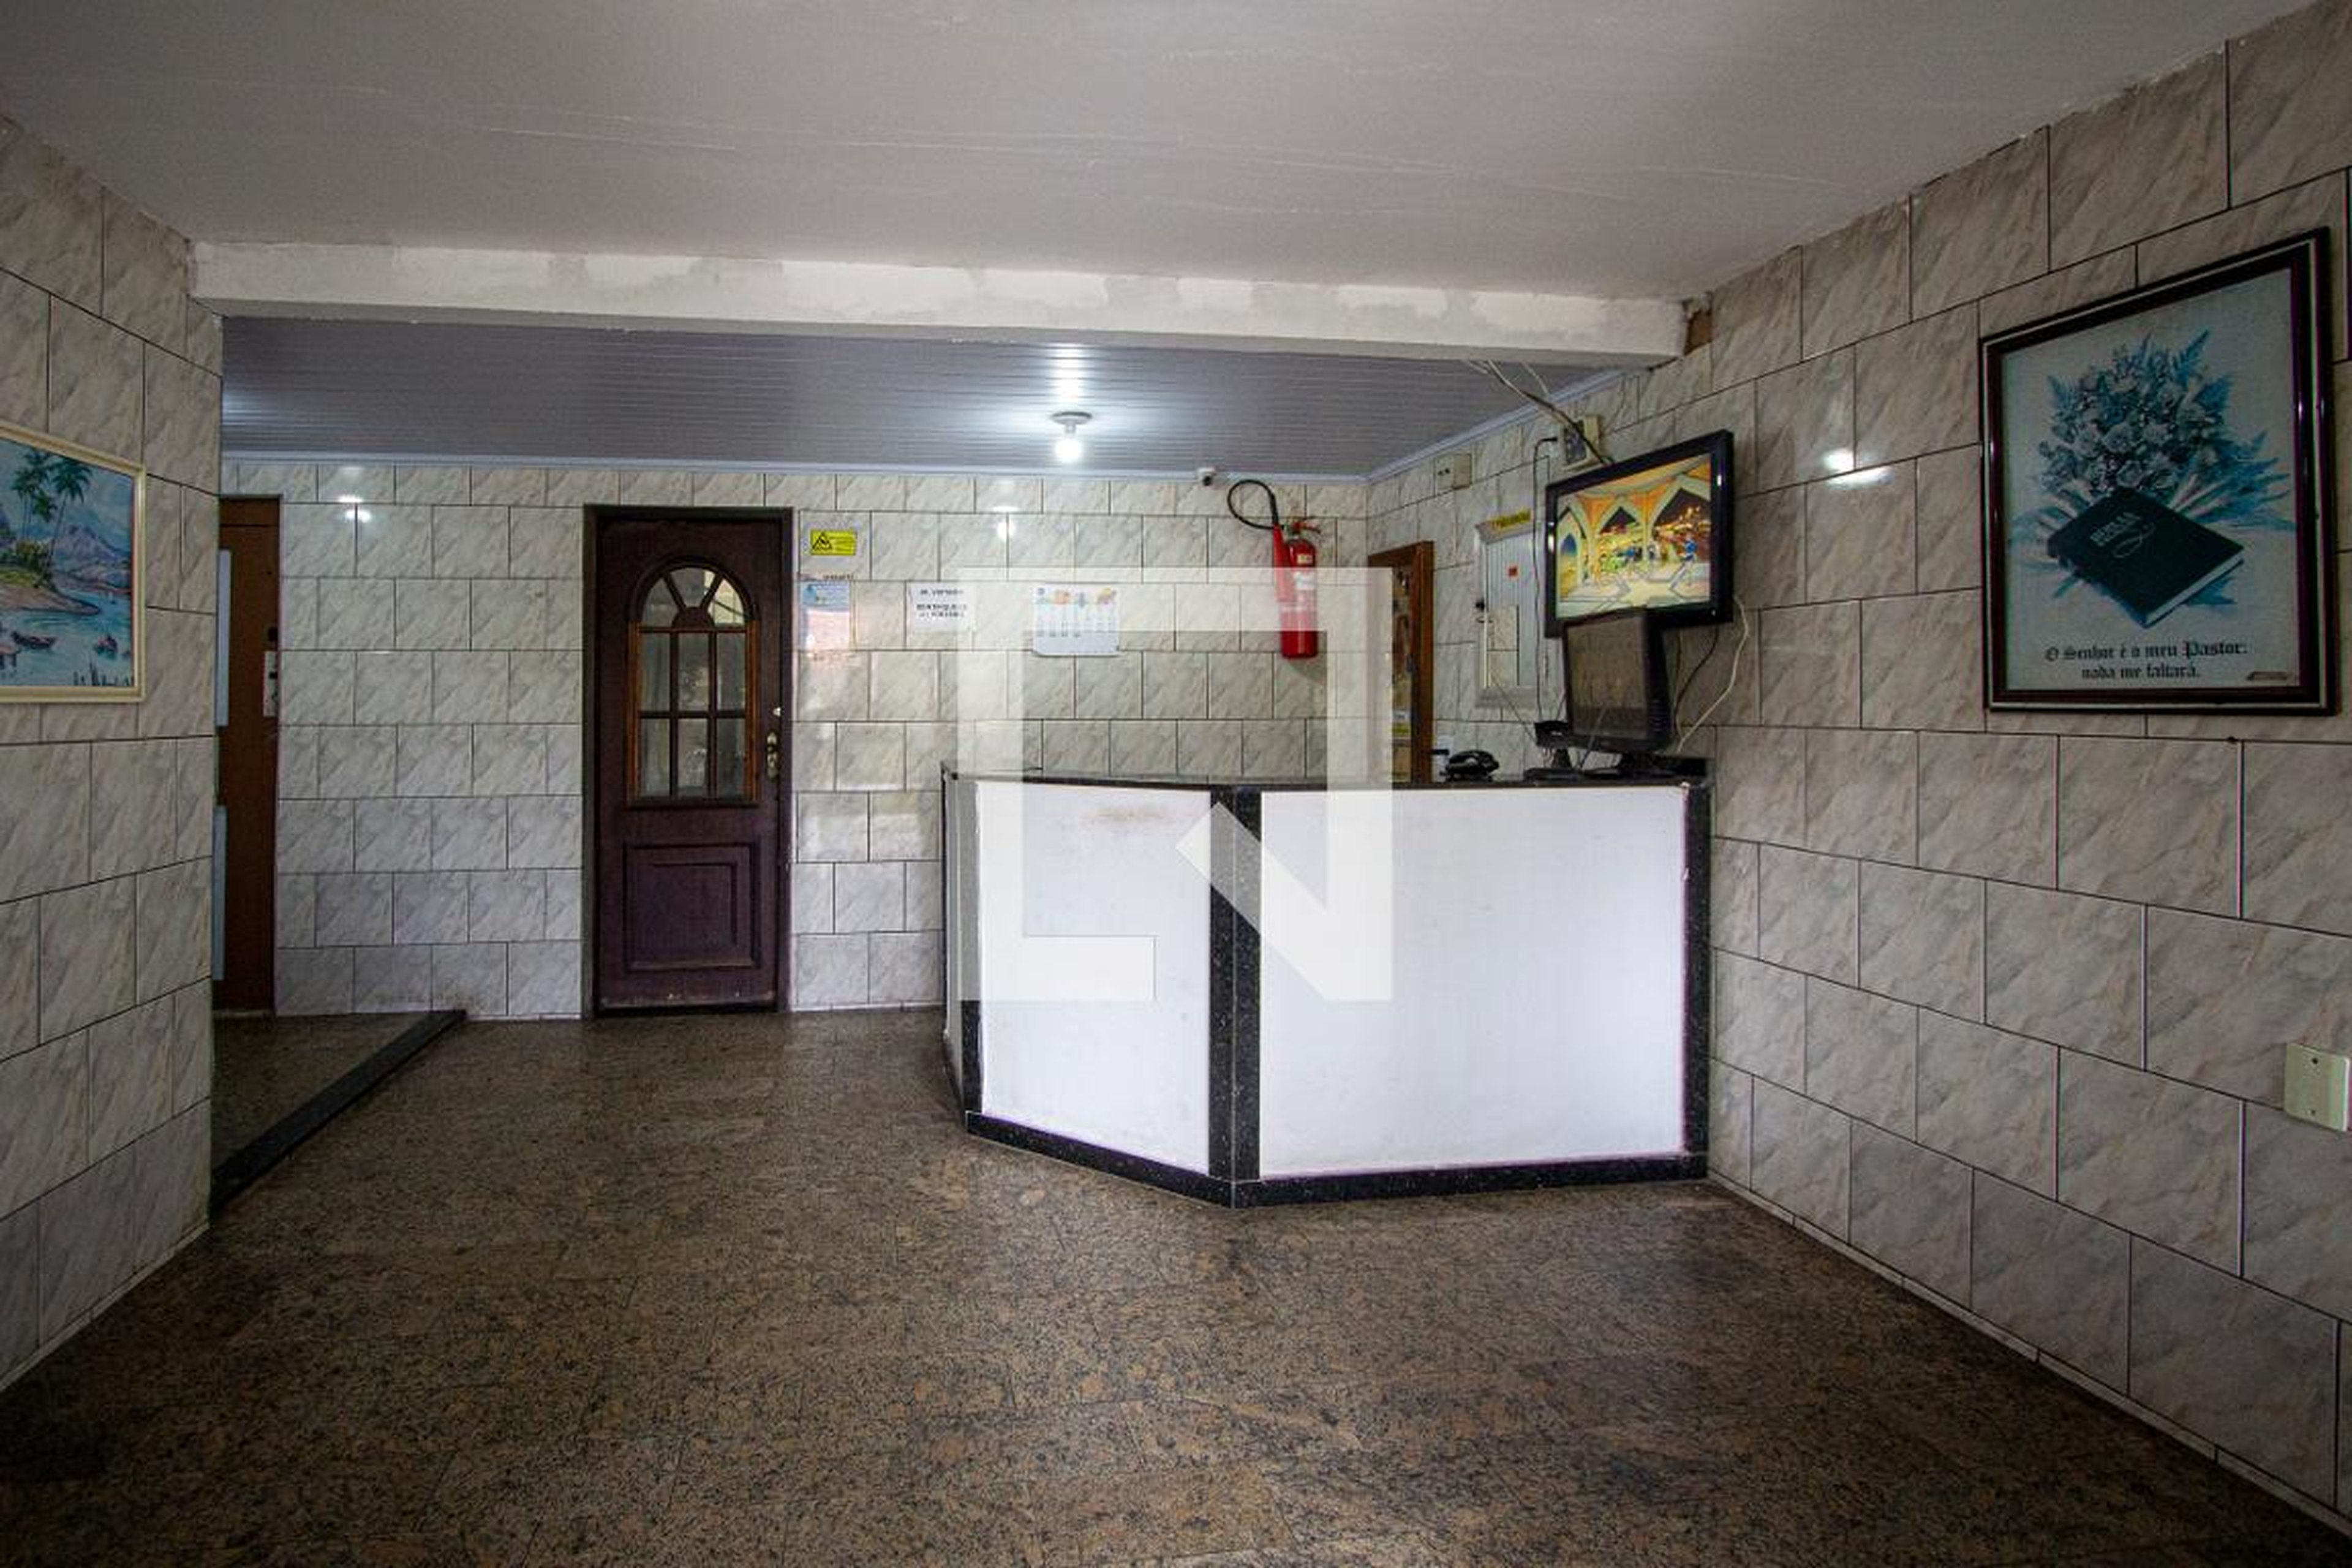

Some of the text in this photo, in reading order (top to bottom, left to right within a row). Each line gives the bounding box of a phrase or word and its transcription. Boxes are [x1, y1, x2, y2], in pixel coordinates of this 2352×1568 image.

[2045, 646, 2059, 662] O
[2144, 645, 2177, 657] meu
[2081, 665, 2116, 679] nada
[2120, 666, 2143, 679] me
